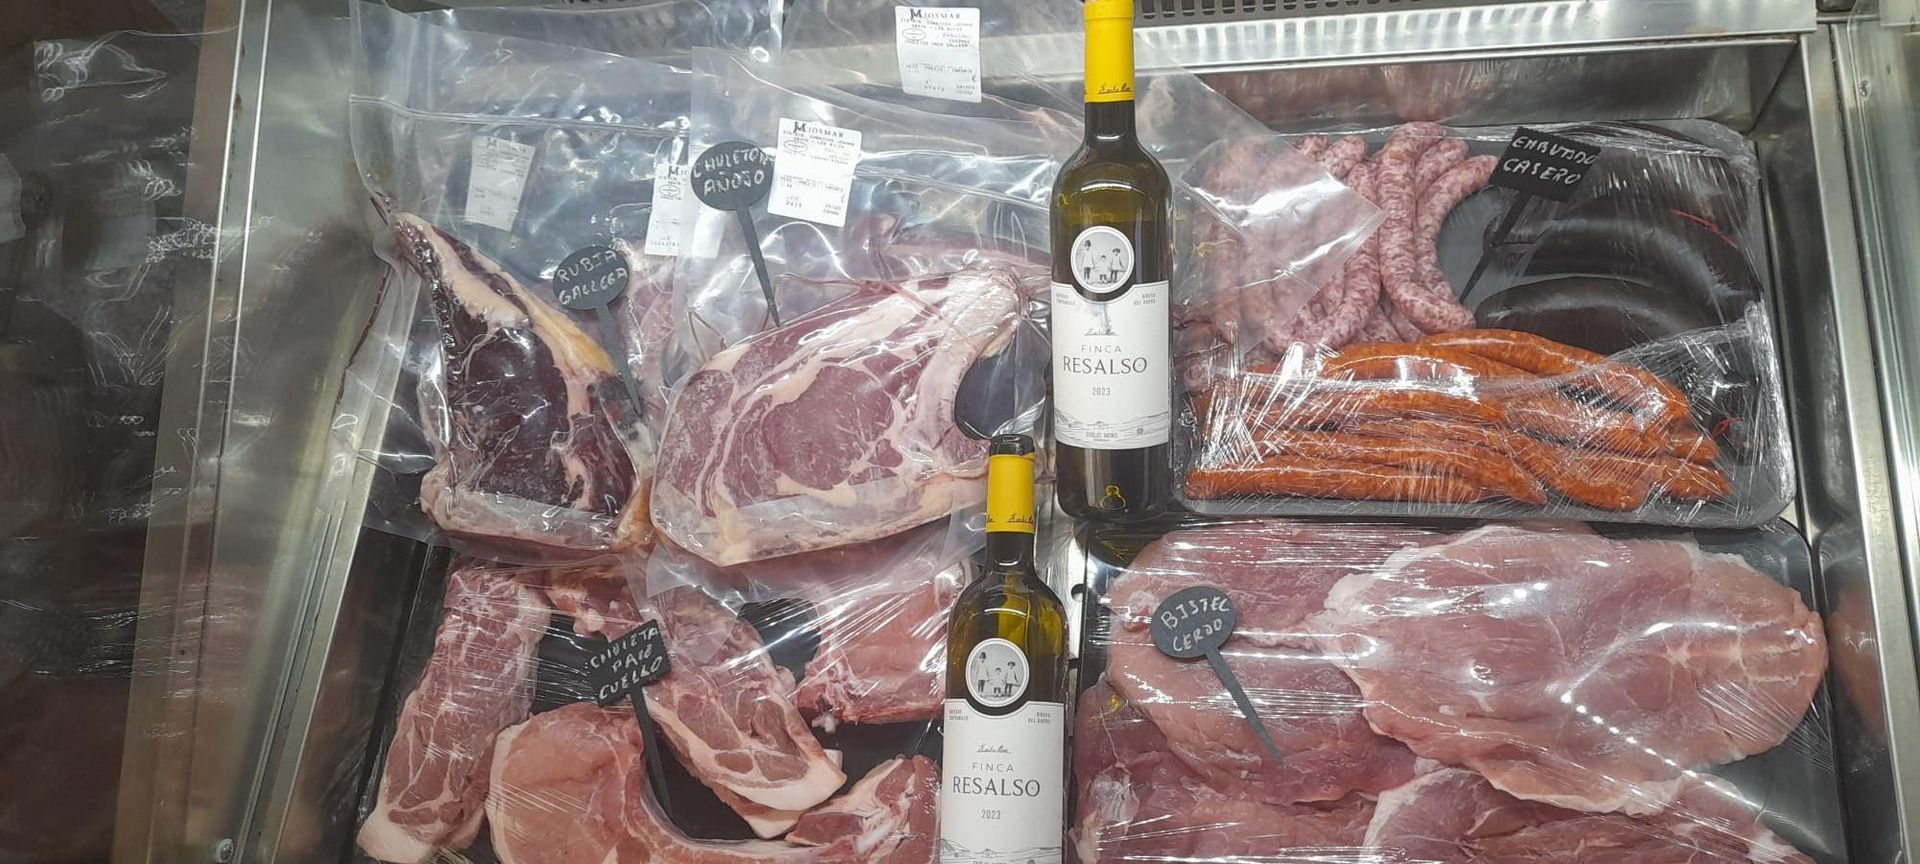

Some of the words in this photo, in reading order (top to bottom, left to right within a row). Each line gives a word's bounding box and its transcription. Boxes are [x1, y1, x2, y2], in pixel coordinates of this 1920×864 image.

[1511, 136, 1599, 165] EMBUTIDO
[1503, 158, 1582, 185] CASERO
[557, 250, 617, 283] RUBIA
[1081, 344, 1122, 354] FINCA
[1063, 356, 1148, 375] RESALSO
[1091, 387, 1111, 396] 2023
[1160, 596, 1230, 631] BISTEC
[1172, 618, 1223, 652] CERDO
[972, 762, 1014, 773] FINCA
[953, 776, 1041, 797] RESALSO
[981, 809, 1001, 820] 2023
